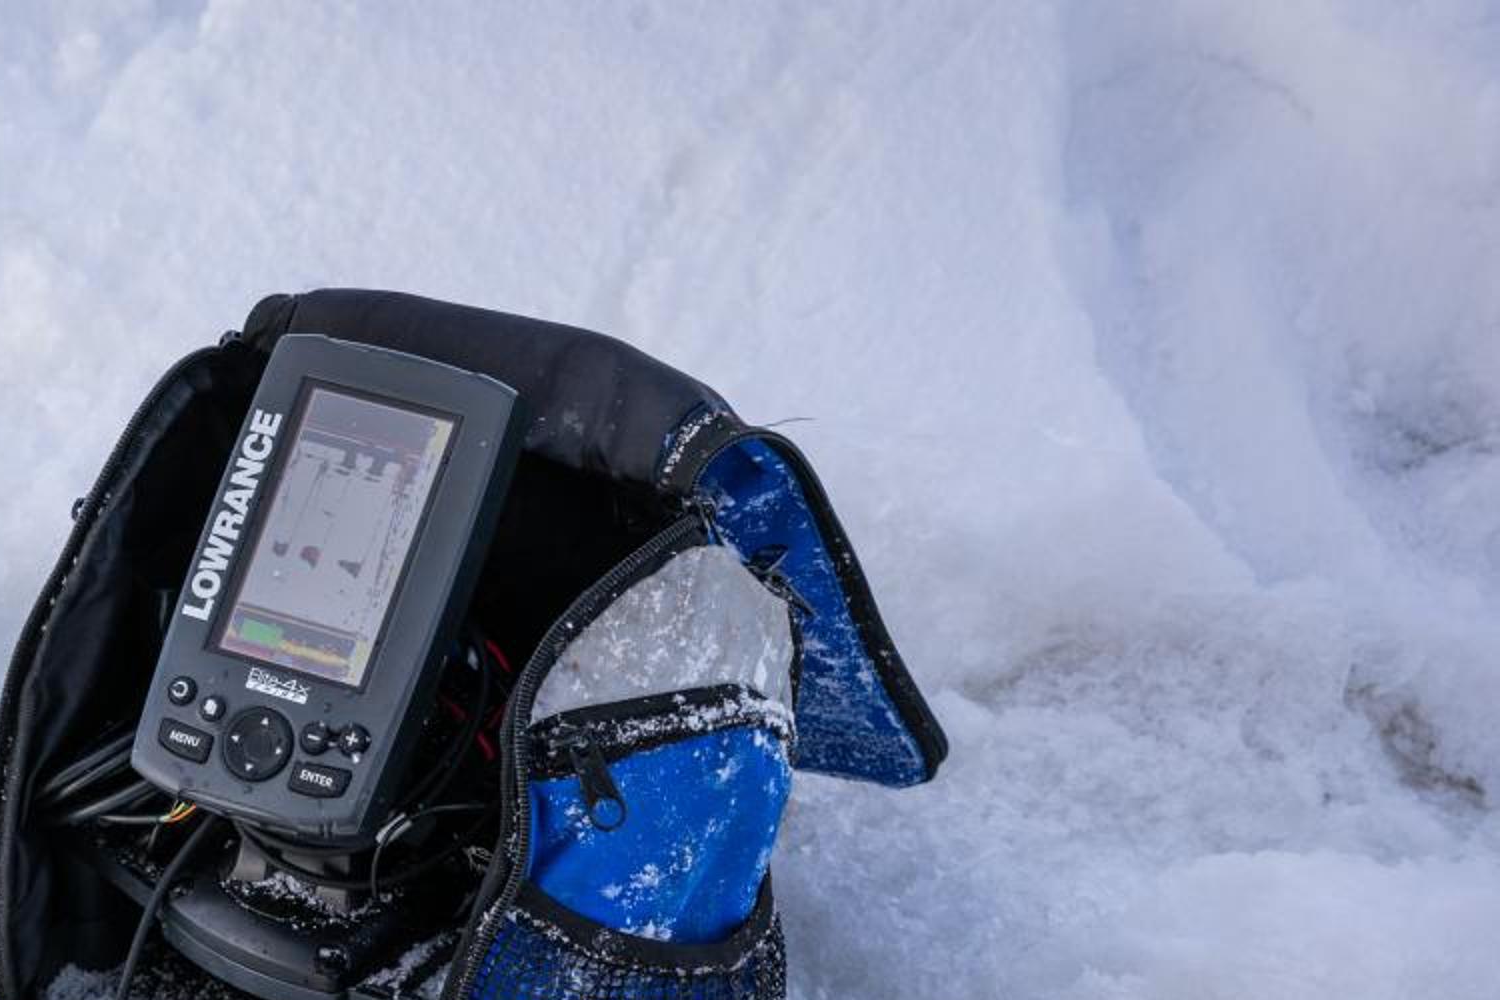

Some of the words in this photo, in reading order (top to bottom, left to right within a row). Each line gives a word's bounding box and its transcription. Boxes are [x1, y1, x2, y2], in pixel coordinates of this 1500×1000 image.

[182, 409, 283, 621] LOWRANCE
[169, 730, 201, 747] MENU
[299, 769, 333, 788] ENTER
